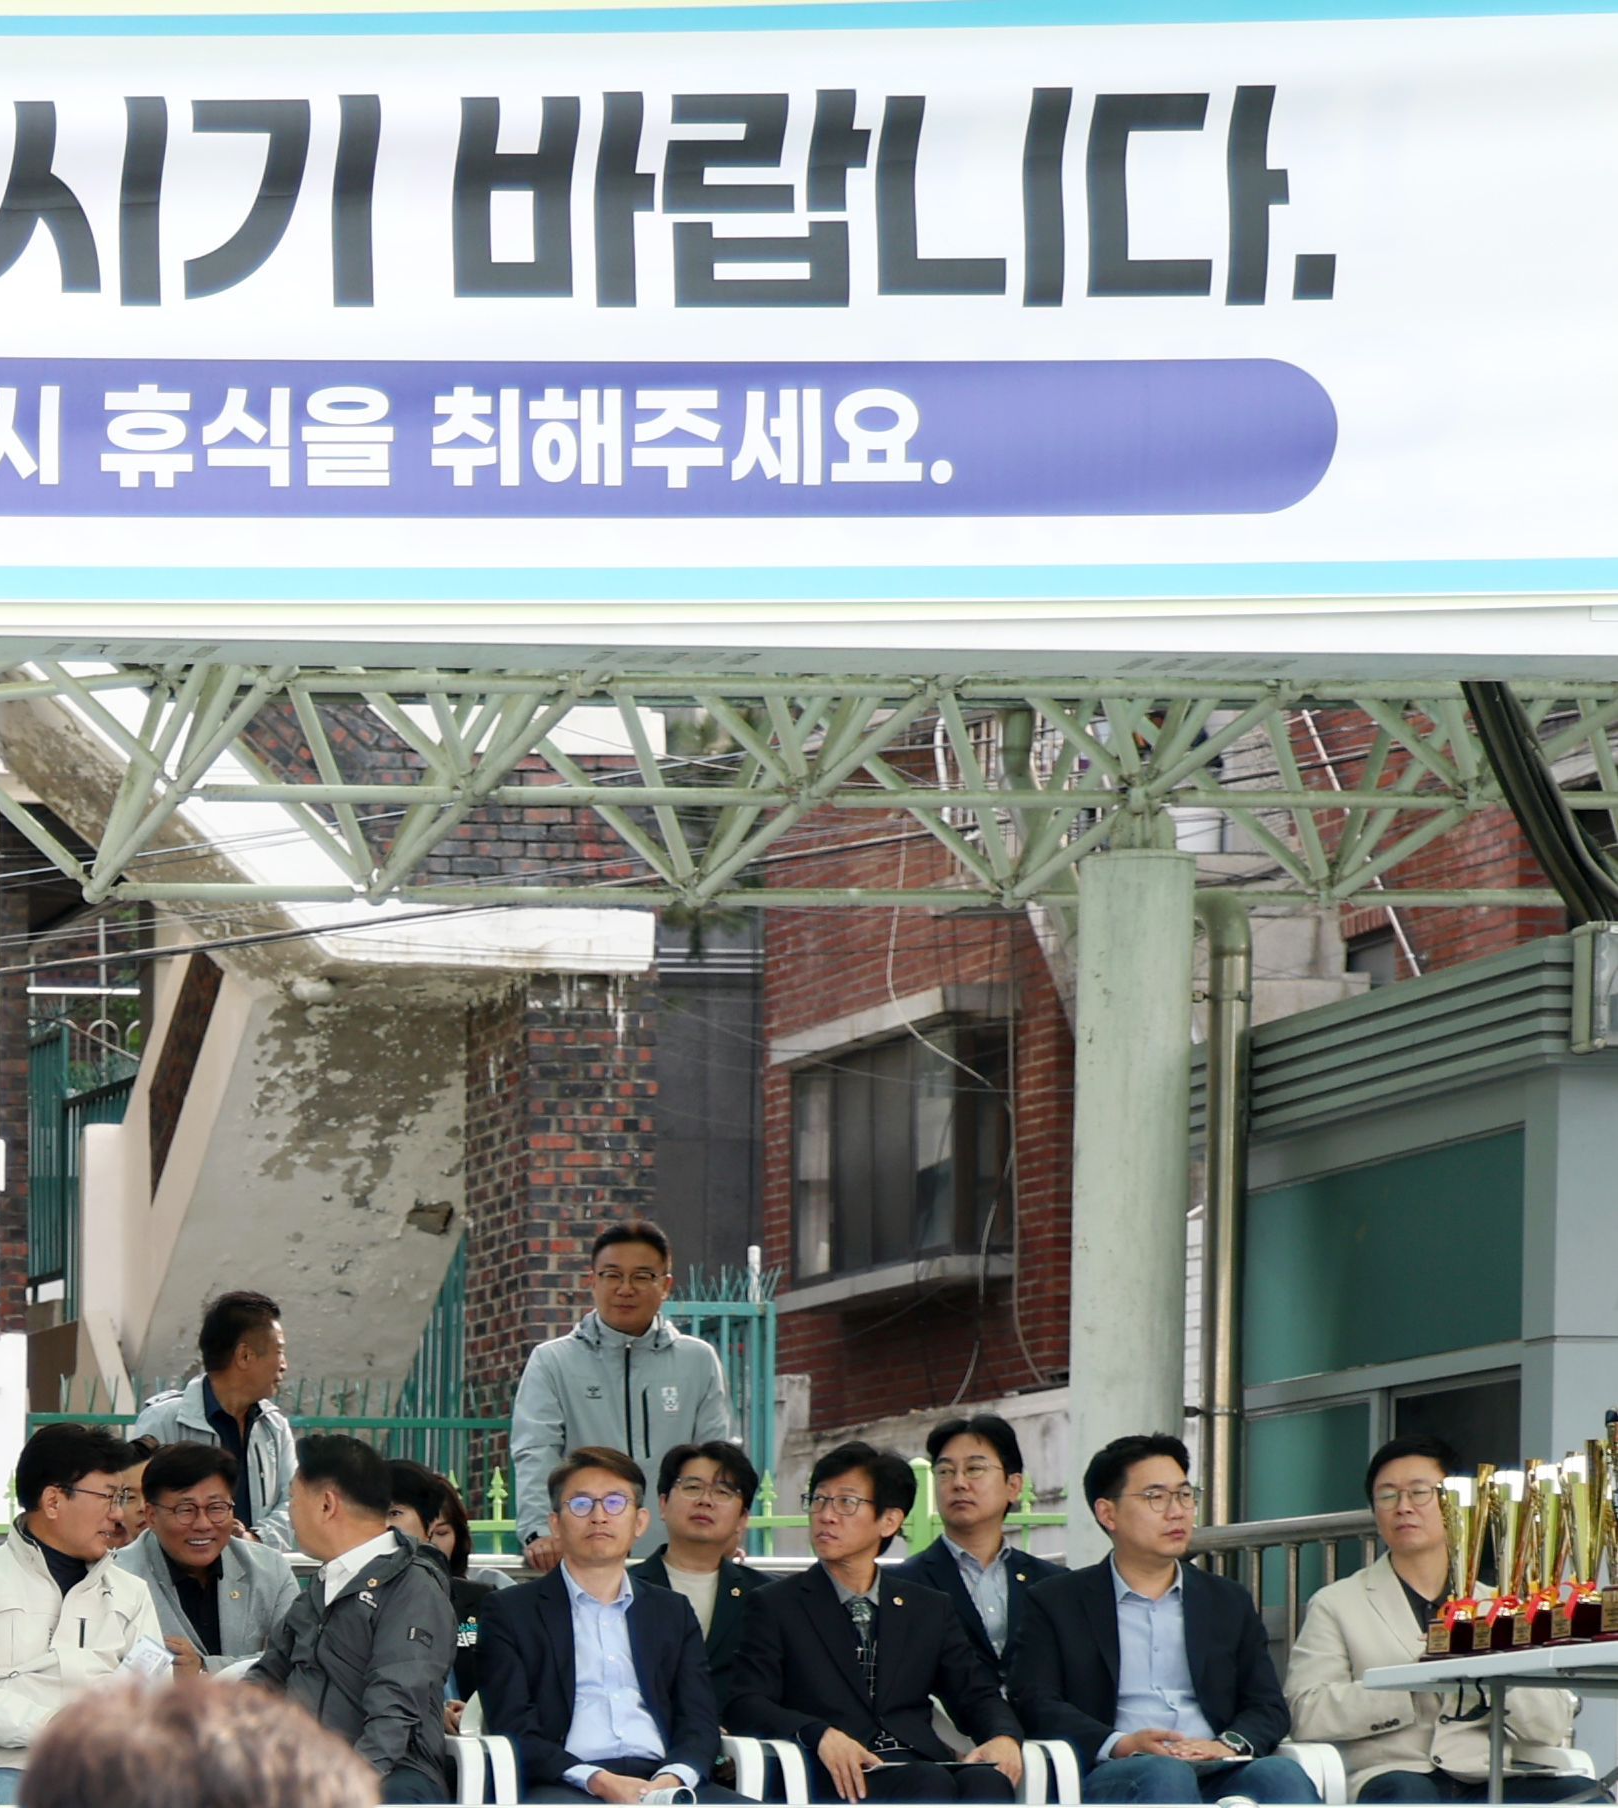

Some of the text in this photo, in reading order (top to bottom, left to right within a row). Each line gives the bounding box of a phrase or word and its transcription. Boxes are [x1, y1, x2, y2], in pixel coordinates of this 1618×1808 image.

[452, 85, 1337, 307] 바랍니다.
[100, 384, 395, 488] 휴식을
[431, 387, 953, 488] 취해주세요.
